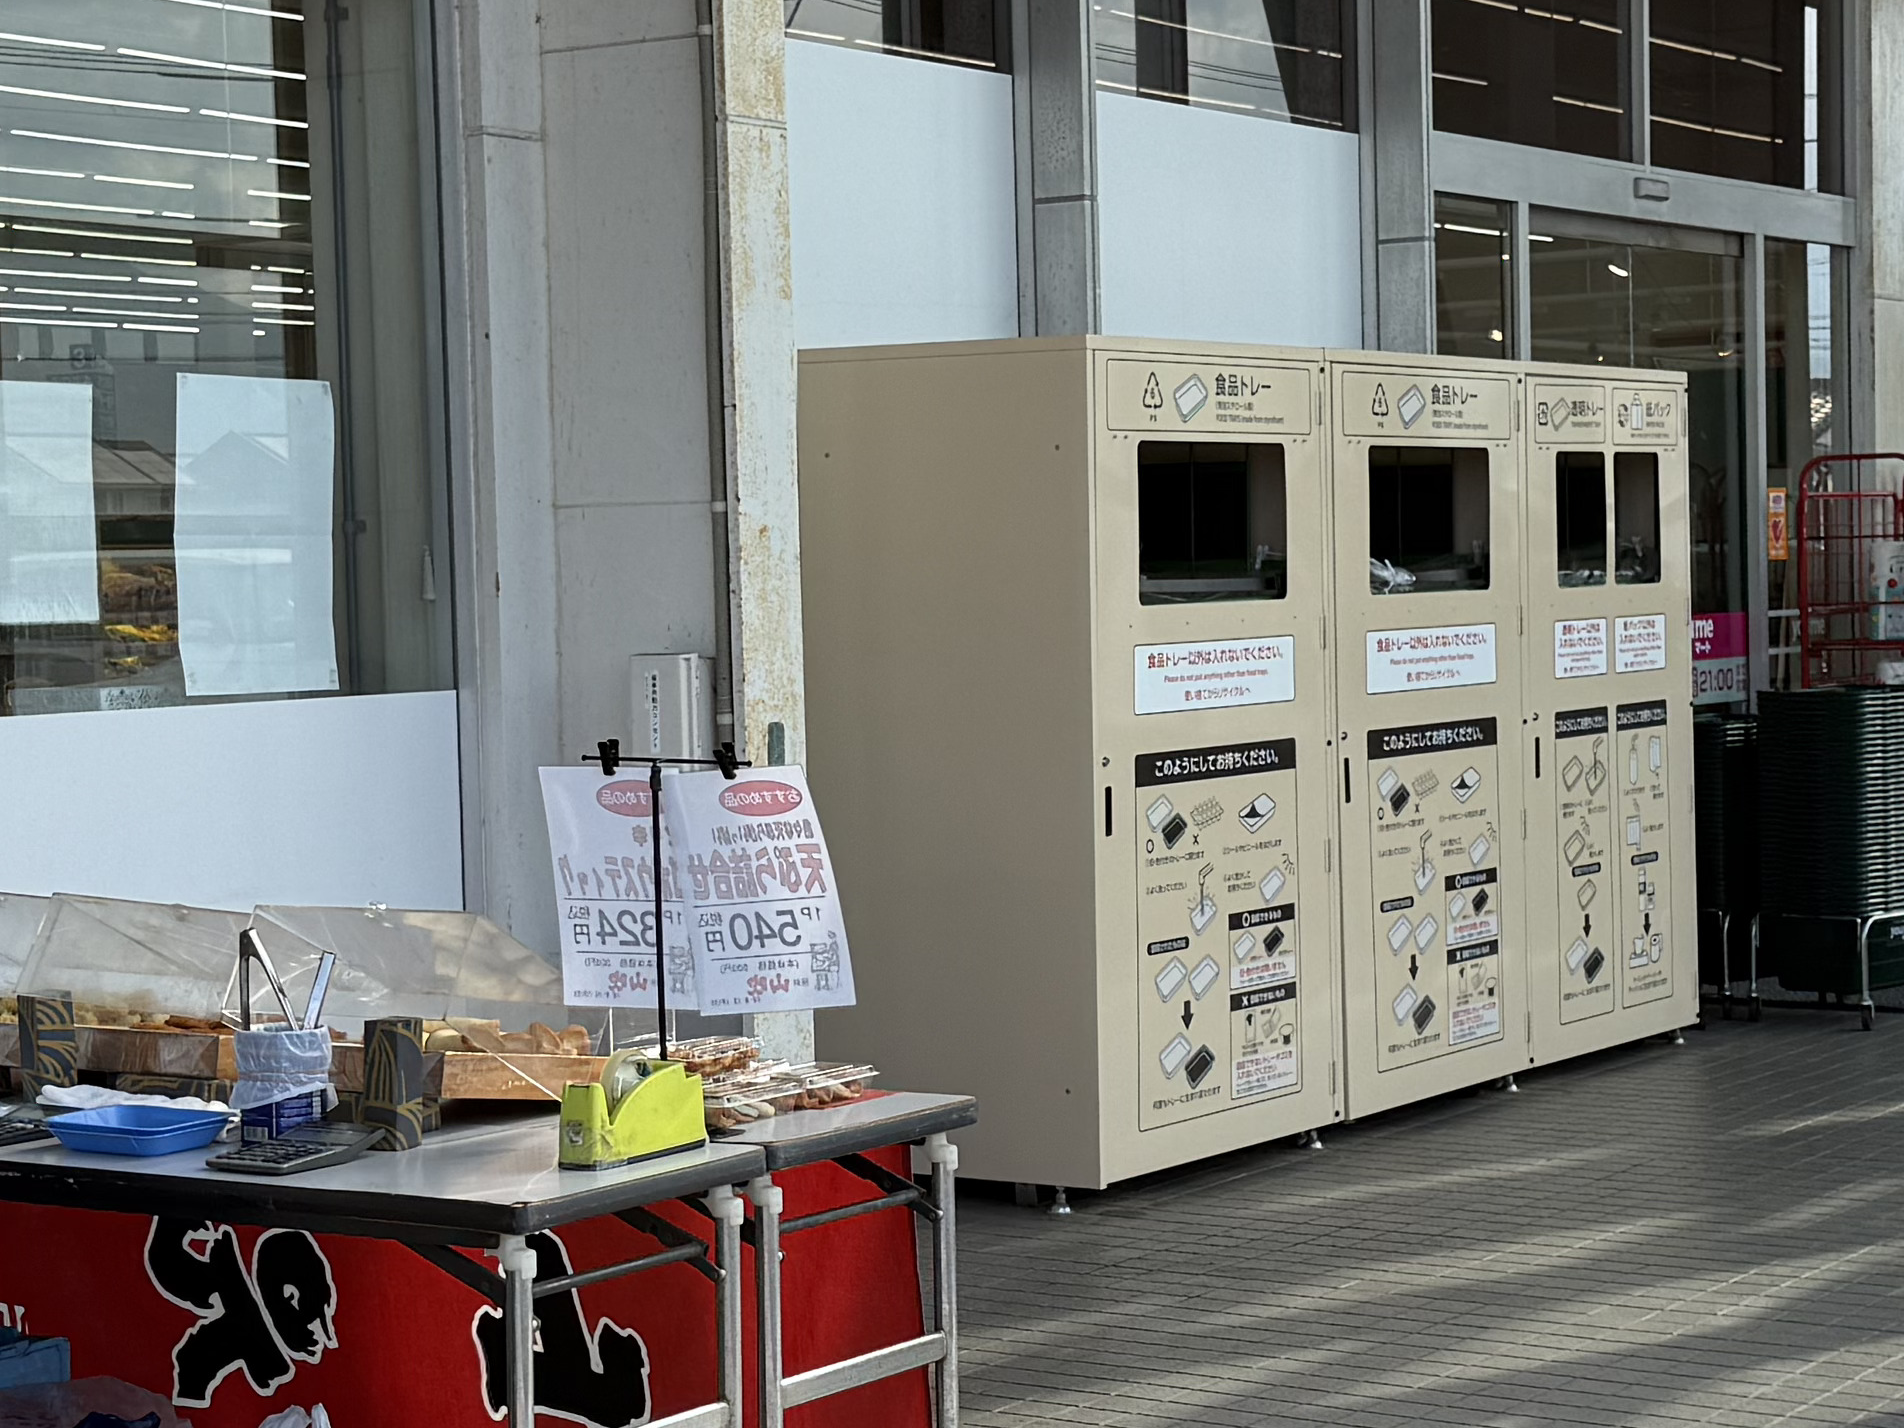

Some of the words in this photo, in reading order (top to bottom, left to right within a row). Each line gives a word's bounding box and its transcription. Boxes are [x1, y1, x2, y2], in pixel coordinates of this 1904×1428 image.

[1215, 373, 1271, 397] 食品トレー
[1431, 384, 1478, 405] 食品トレー
[1699, 668, 1734, 693] 21:00
[1383, 726, 1484, 751] このようにしてお持ちください。
[1154, 748, 1279, 778] このようにしてお持ちください。
